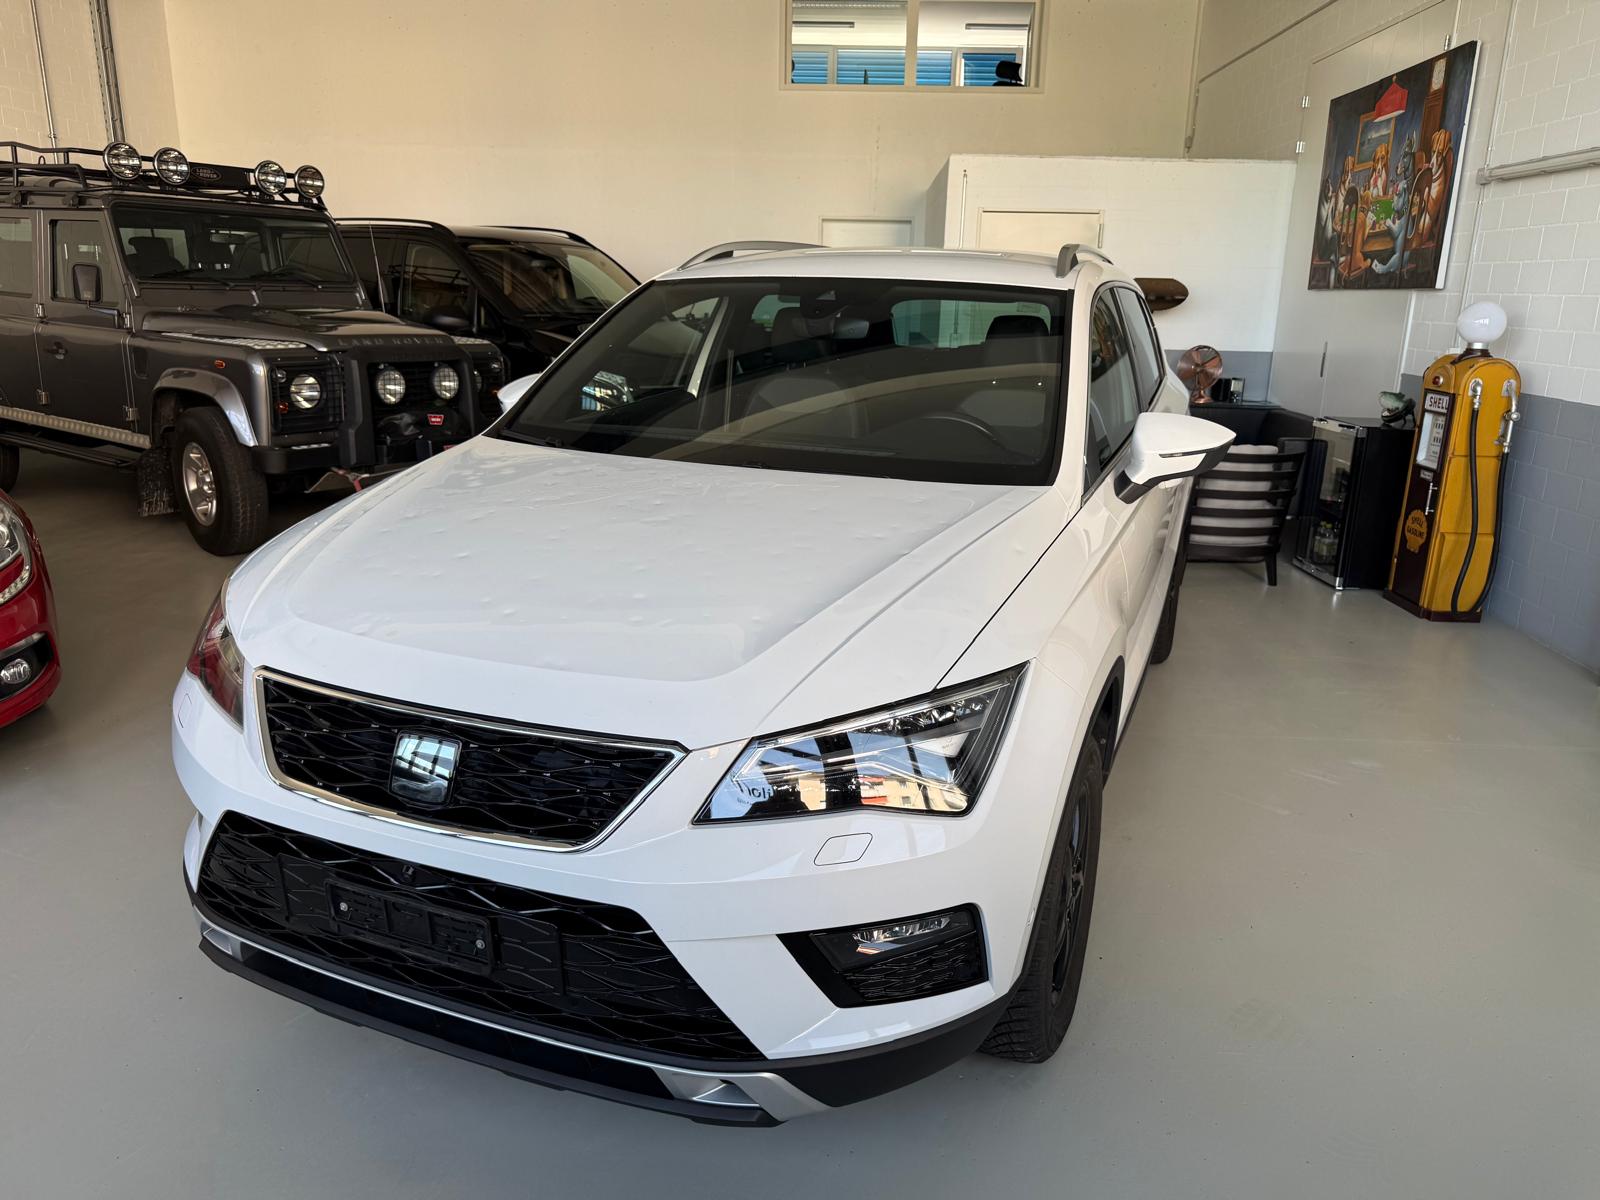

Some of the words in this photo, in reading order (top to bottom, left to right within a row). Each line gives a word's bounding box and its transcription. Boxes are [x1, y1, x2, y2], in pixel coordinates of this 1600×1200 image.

[338, 338, 385, 346] LAND
[391, 337, 444, 345] ROVER
[1429, 396, 1448, 410] SHELL
